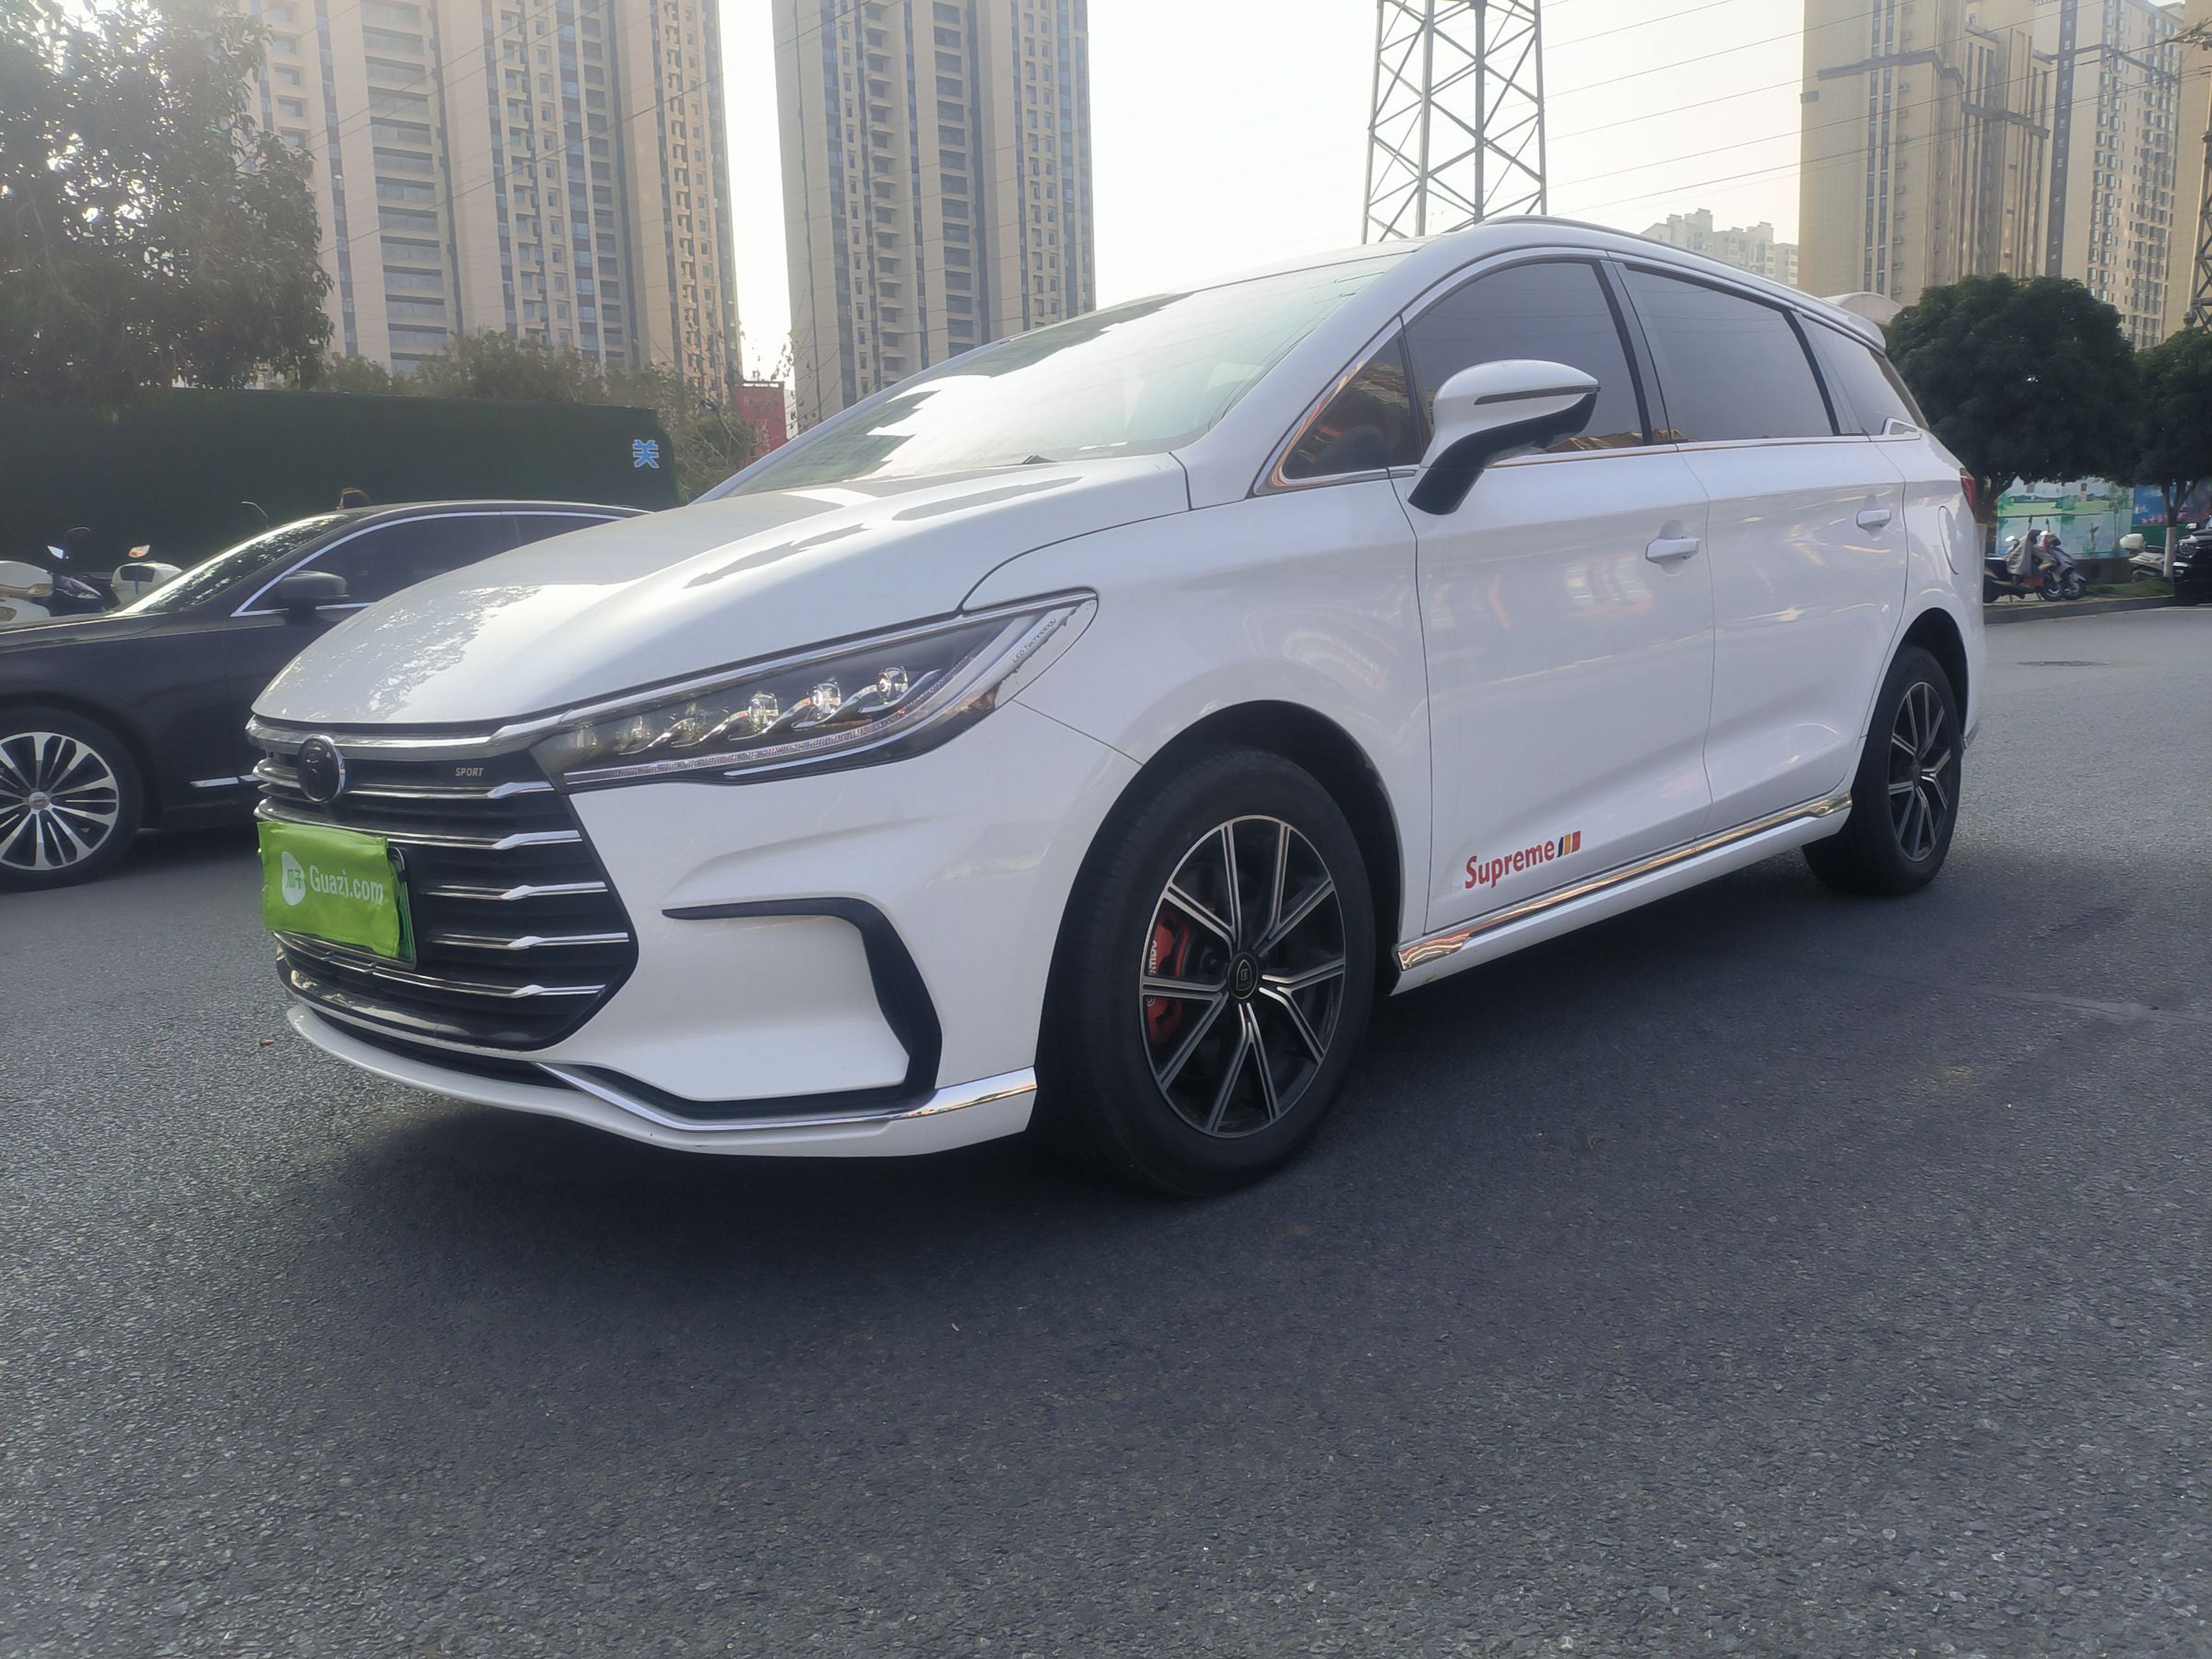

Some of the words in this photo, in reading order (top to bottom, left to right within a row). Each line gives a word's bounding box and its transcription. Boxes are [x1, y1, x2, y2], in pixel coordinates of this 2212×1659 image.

[632, 440, 660, 468] 关
[455, 767, 484, 777] SPORT
[1465, 840, 1555, 889] Supreme
[309, 865, 384, 904] Guazi.com
